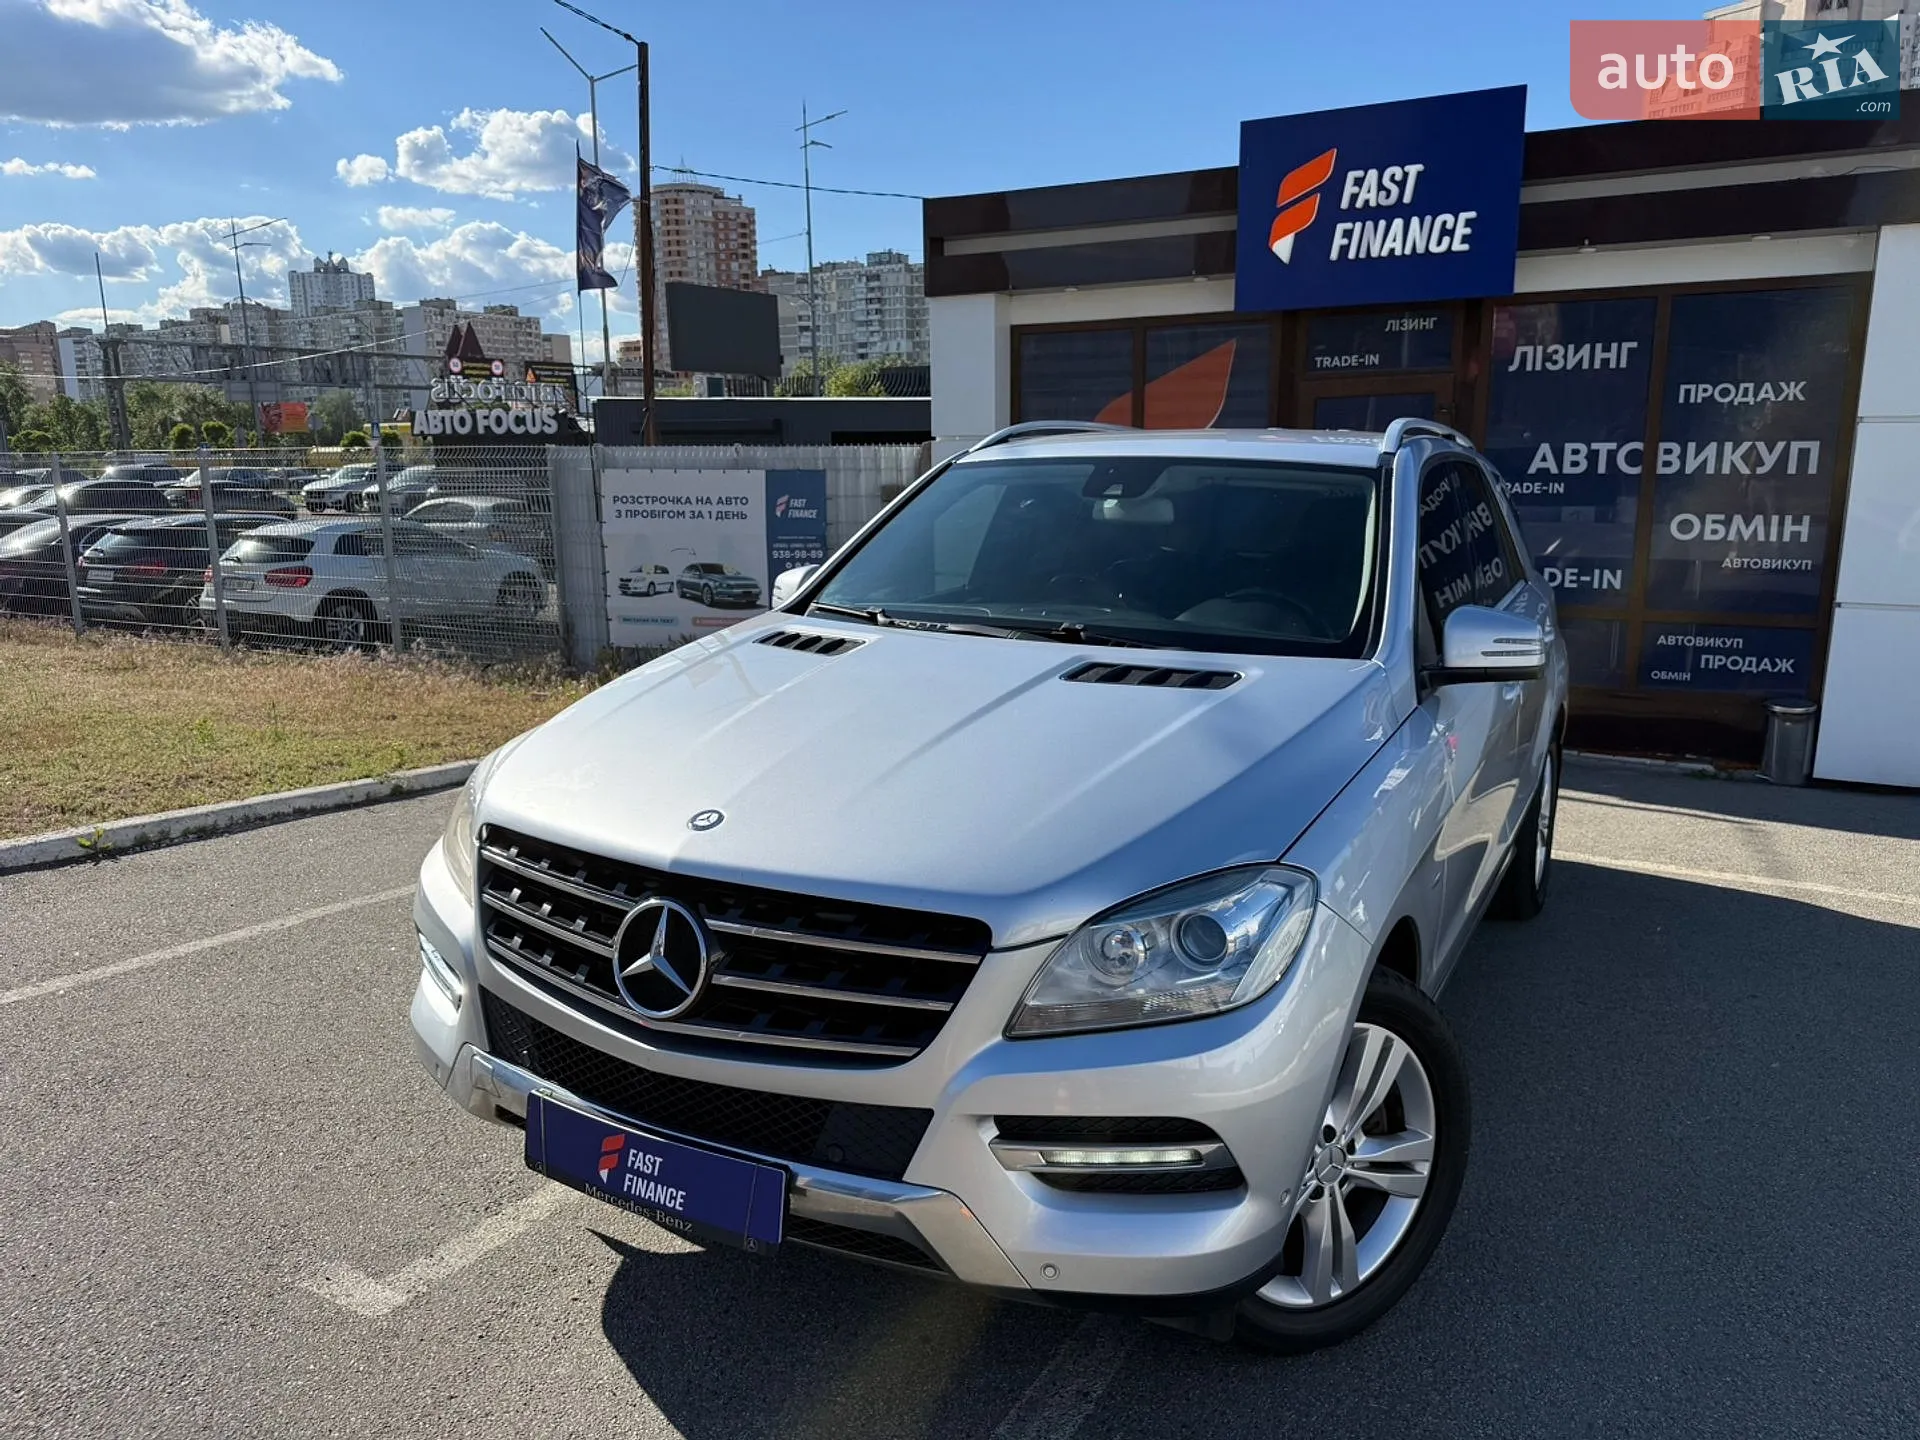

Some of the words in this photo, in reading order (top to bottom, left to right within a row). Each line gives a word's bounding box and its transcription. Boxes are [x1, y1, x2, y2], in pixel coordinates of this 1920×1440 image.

[1340, 164, 1424, 209] FAST
[1329, 211, 1477, 261] FINANCE
[1385, 317, 1438, 332] ЛІЗИНГ
[1314, 354, 1379, 369] TRADE-IN
[1508, 342, 1638, 372] ЛІЗИНГ
[1678, 381, 1807, 405] ПРОДАЖ
[413, 409, 473, 435] АВТО
[476, 408, 558, 435] FOCUS
[613, 495, 692, 506] РОЗСТРОЧКА
[696, 496, 713, 506] НА
[717, 496, 749, 507] АВТО
[789, 499, 807, 508] FAST
[625, 510, 686, 520] ПРОБІГОМ
[689, 510, 704, 520] ЗА
[708, 511, 713, 520] 1
[715, 511, 748, 521] ДЕНЬ
[787, 509, 818, 519] FINANCE
[1670, 513, 1811, 542] ОБМІН
[1721, 557, 1812, 571] АВТОВИКУП
[1657, 635, 1743, 649] АВТОВИКУП
[1700, 654, 1796, 673] ПРОДАЖ
[1651, 670, 1691, 681] ОБМІН
[627, 1148, 663, 1176] FAST
[623, 1173, 686, 1211] FINANCE
[584, 1183, 693, 1232] Mercedes-Benz
